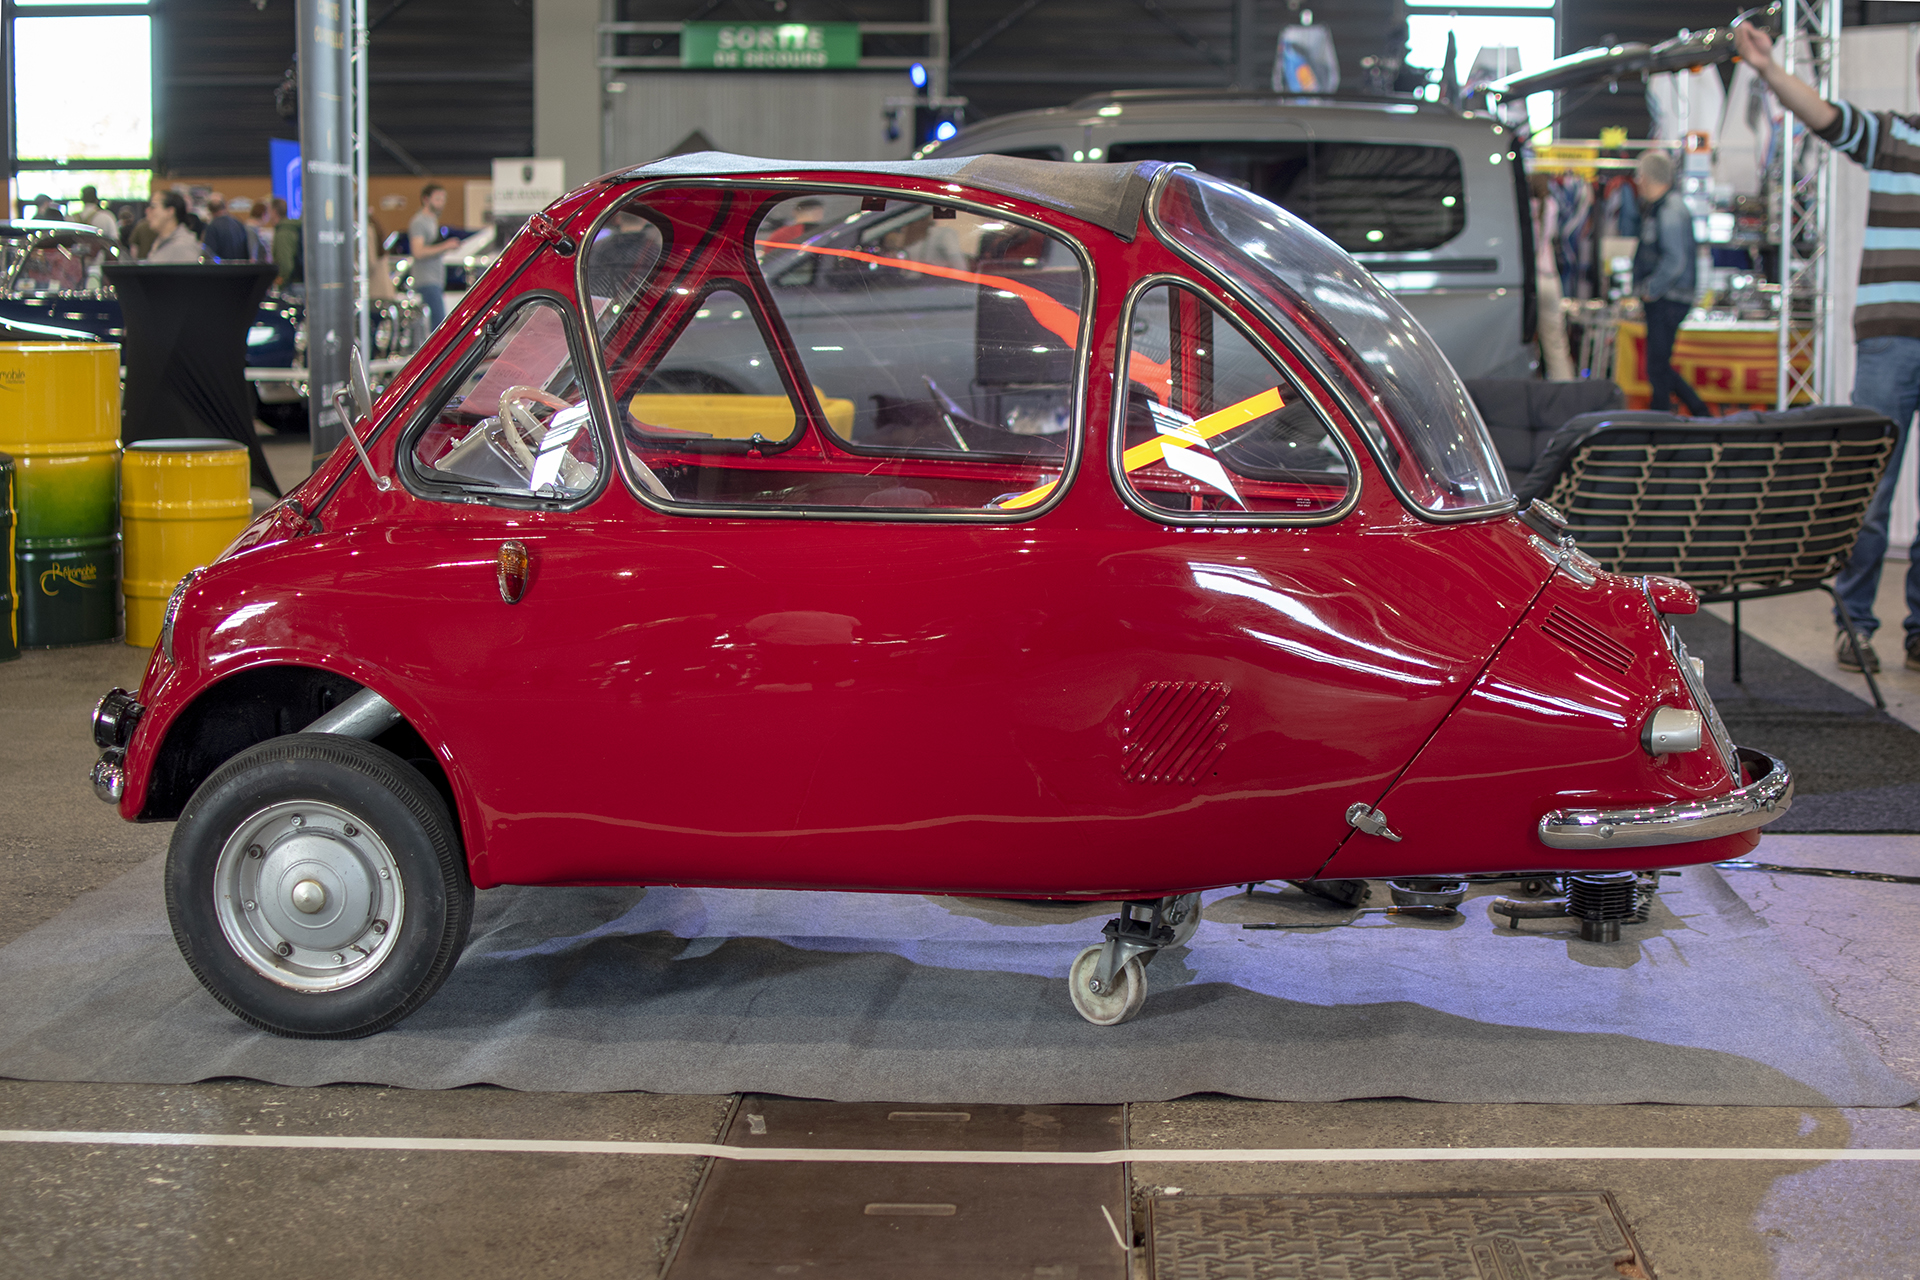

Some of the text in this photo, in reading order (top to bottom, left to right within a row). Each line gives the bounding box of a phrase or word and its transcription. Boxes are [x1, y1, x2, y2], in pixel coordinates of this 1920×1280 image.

[717, 26, 824, 49] SORTIE
[713, 50, 828, 67] DE SECOURS
